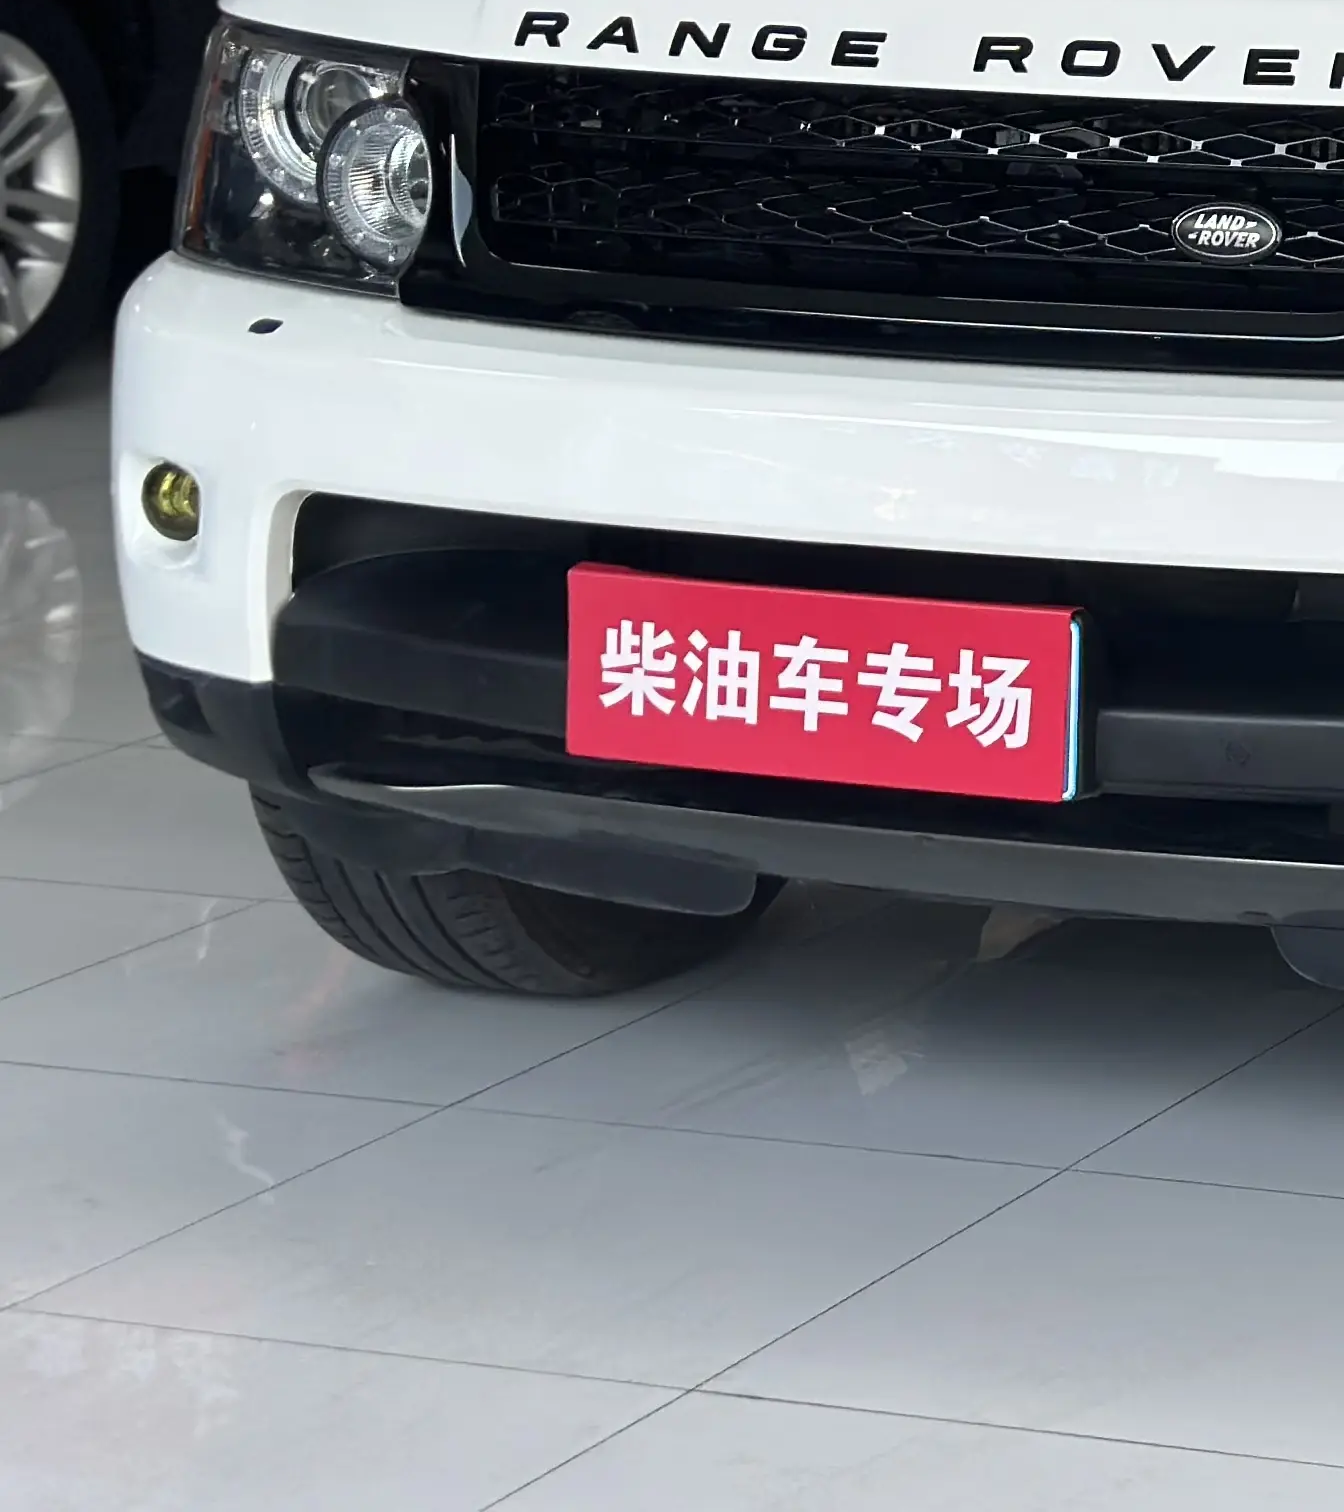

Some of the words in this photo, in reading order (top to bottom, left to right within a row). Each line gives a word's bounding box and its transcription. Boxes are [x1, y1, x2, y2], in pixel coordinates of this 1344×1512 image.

[513, 11, 888, 67] RANGE
[1193, 213, 1246, 231] LAND
[1197, 230, 1261, 249] ROVER
[598, 619, 1033, 749] 柴油车专场
